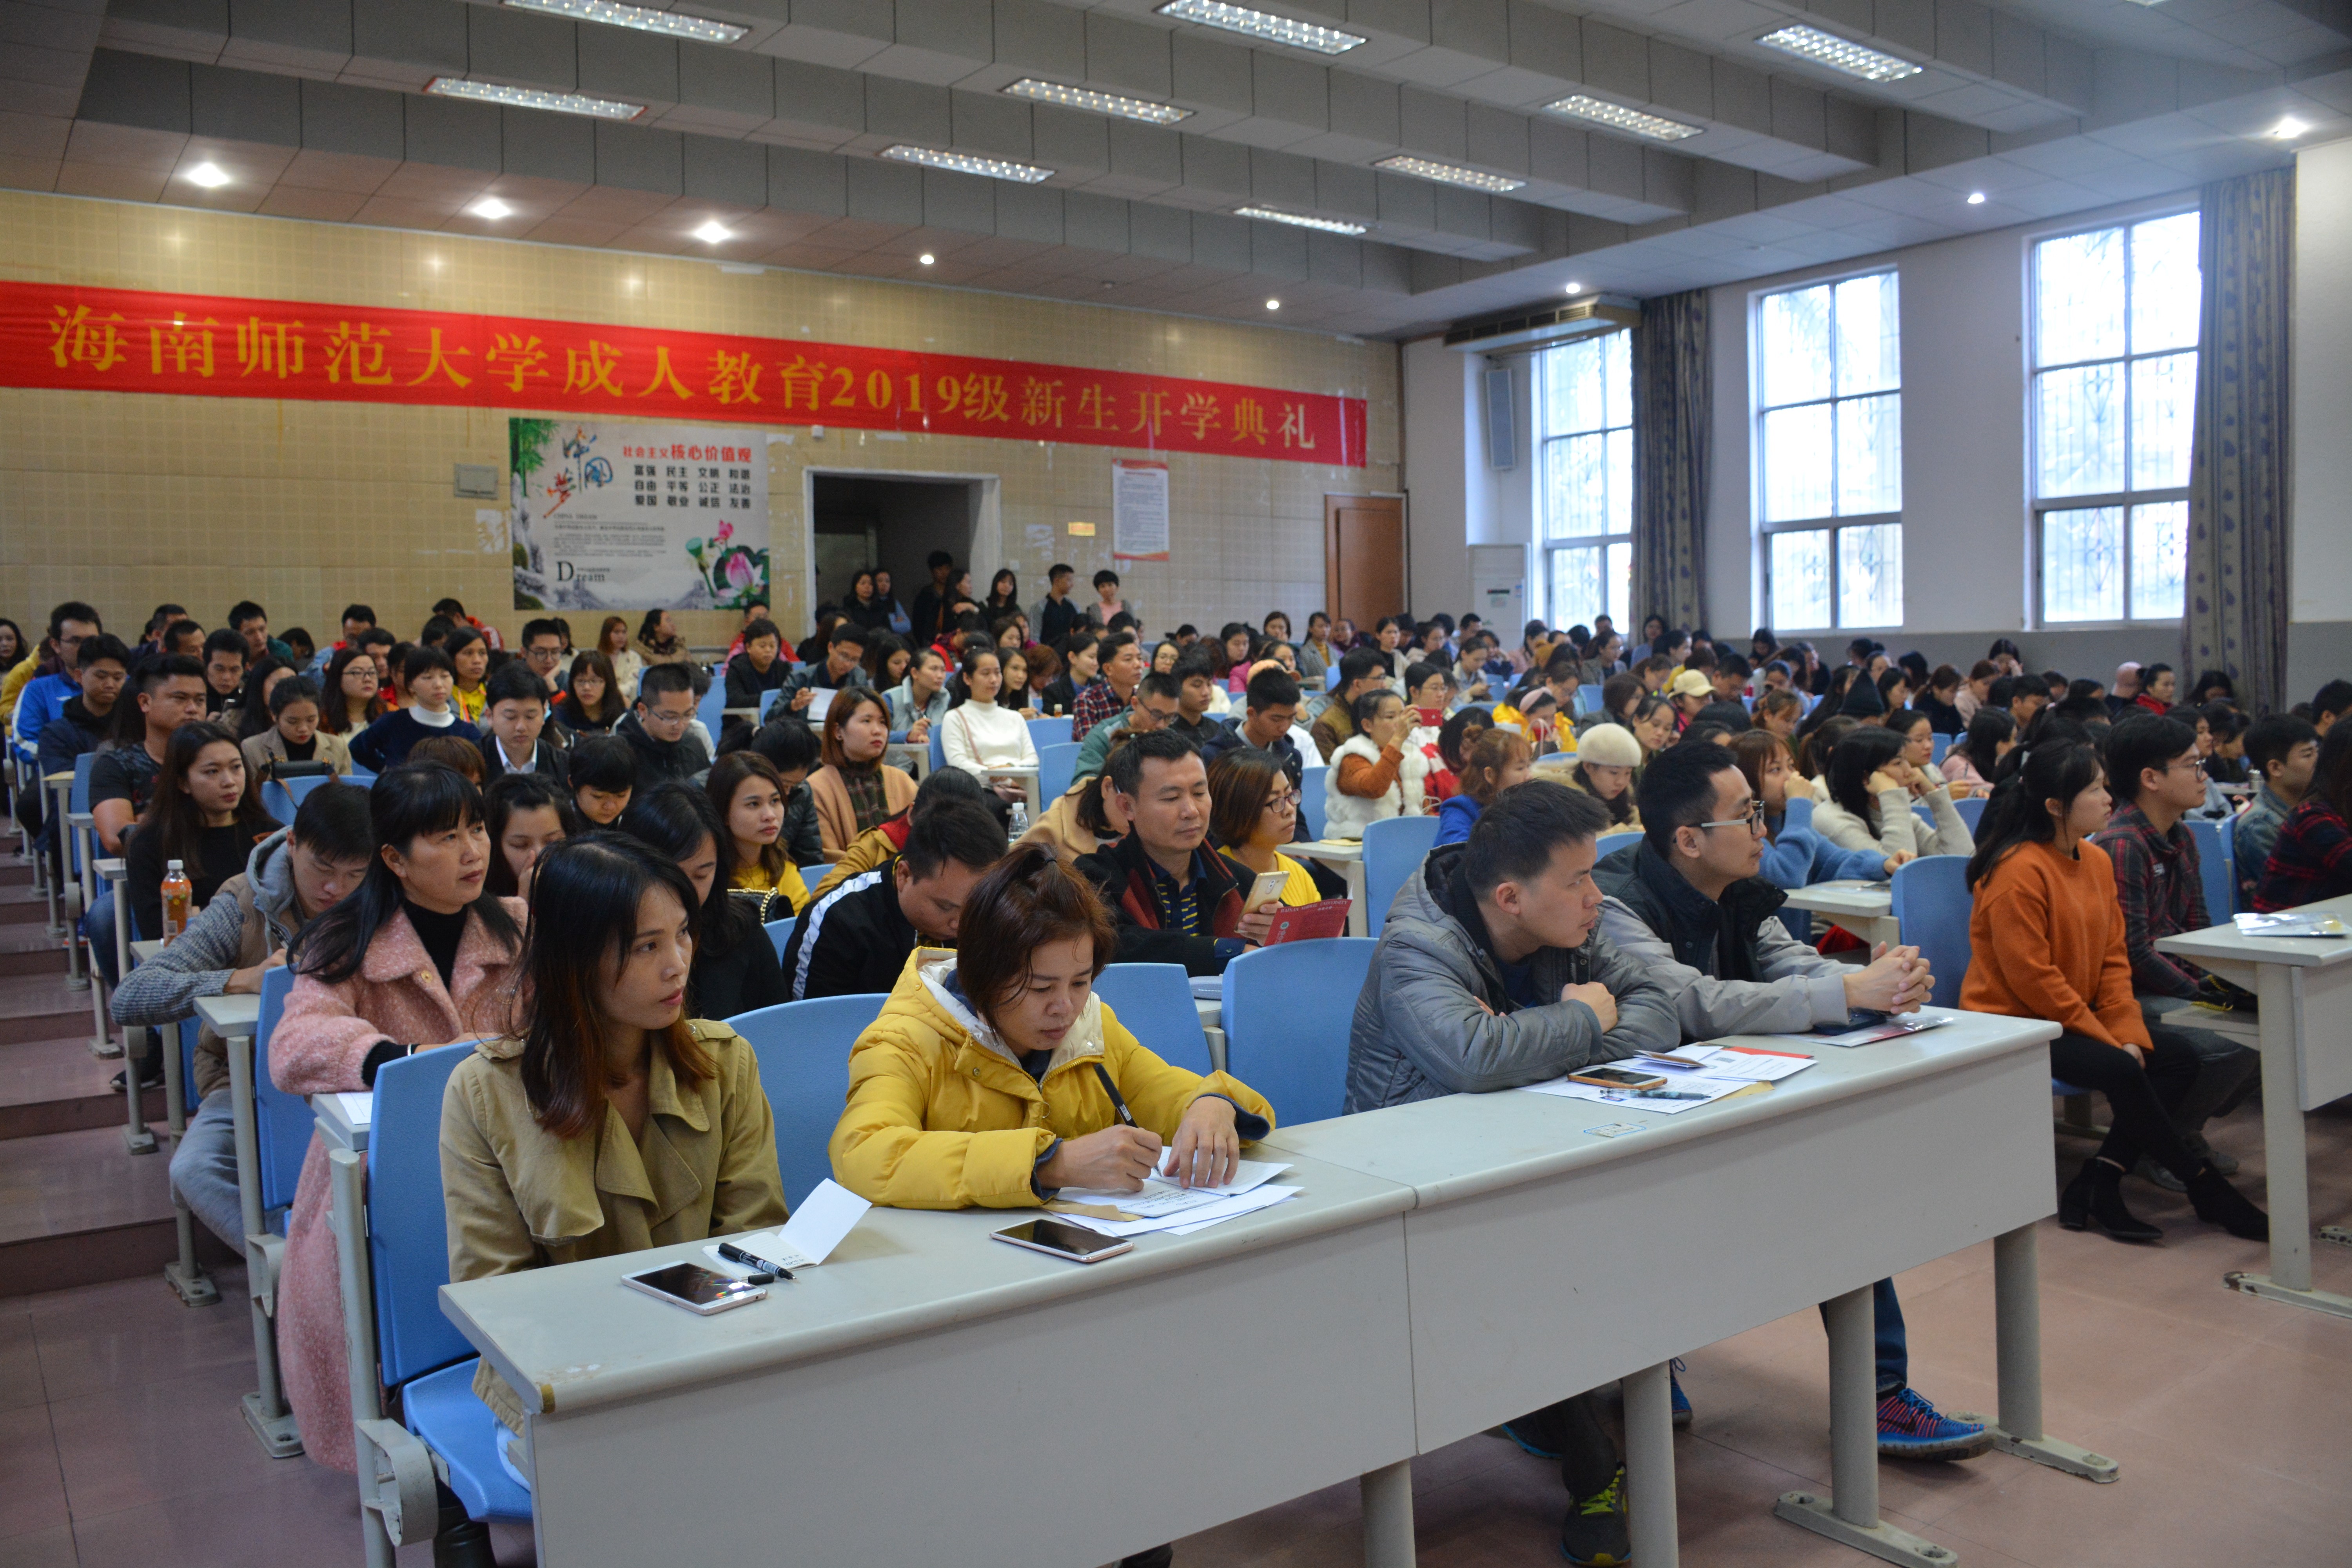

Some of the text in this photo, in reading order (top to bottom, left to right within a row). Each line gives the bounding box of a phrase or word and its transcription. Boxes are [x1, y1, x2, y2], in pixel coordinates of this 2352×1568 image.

[48, 304, 1316, 448] 海南师范大学成人教育2019级新生开学典礼
[623, 444, 751, 463] 社会主义核心价值观
[634, 464, 750, 480] 富强 民主 文明 和谐
[635, 479, 751, 495] 自由 平等 公正 法治
[635, 495, 750, 509] 爱国 敬业 诚信 友善
